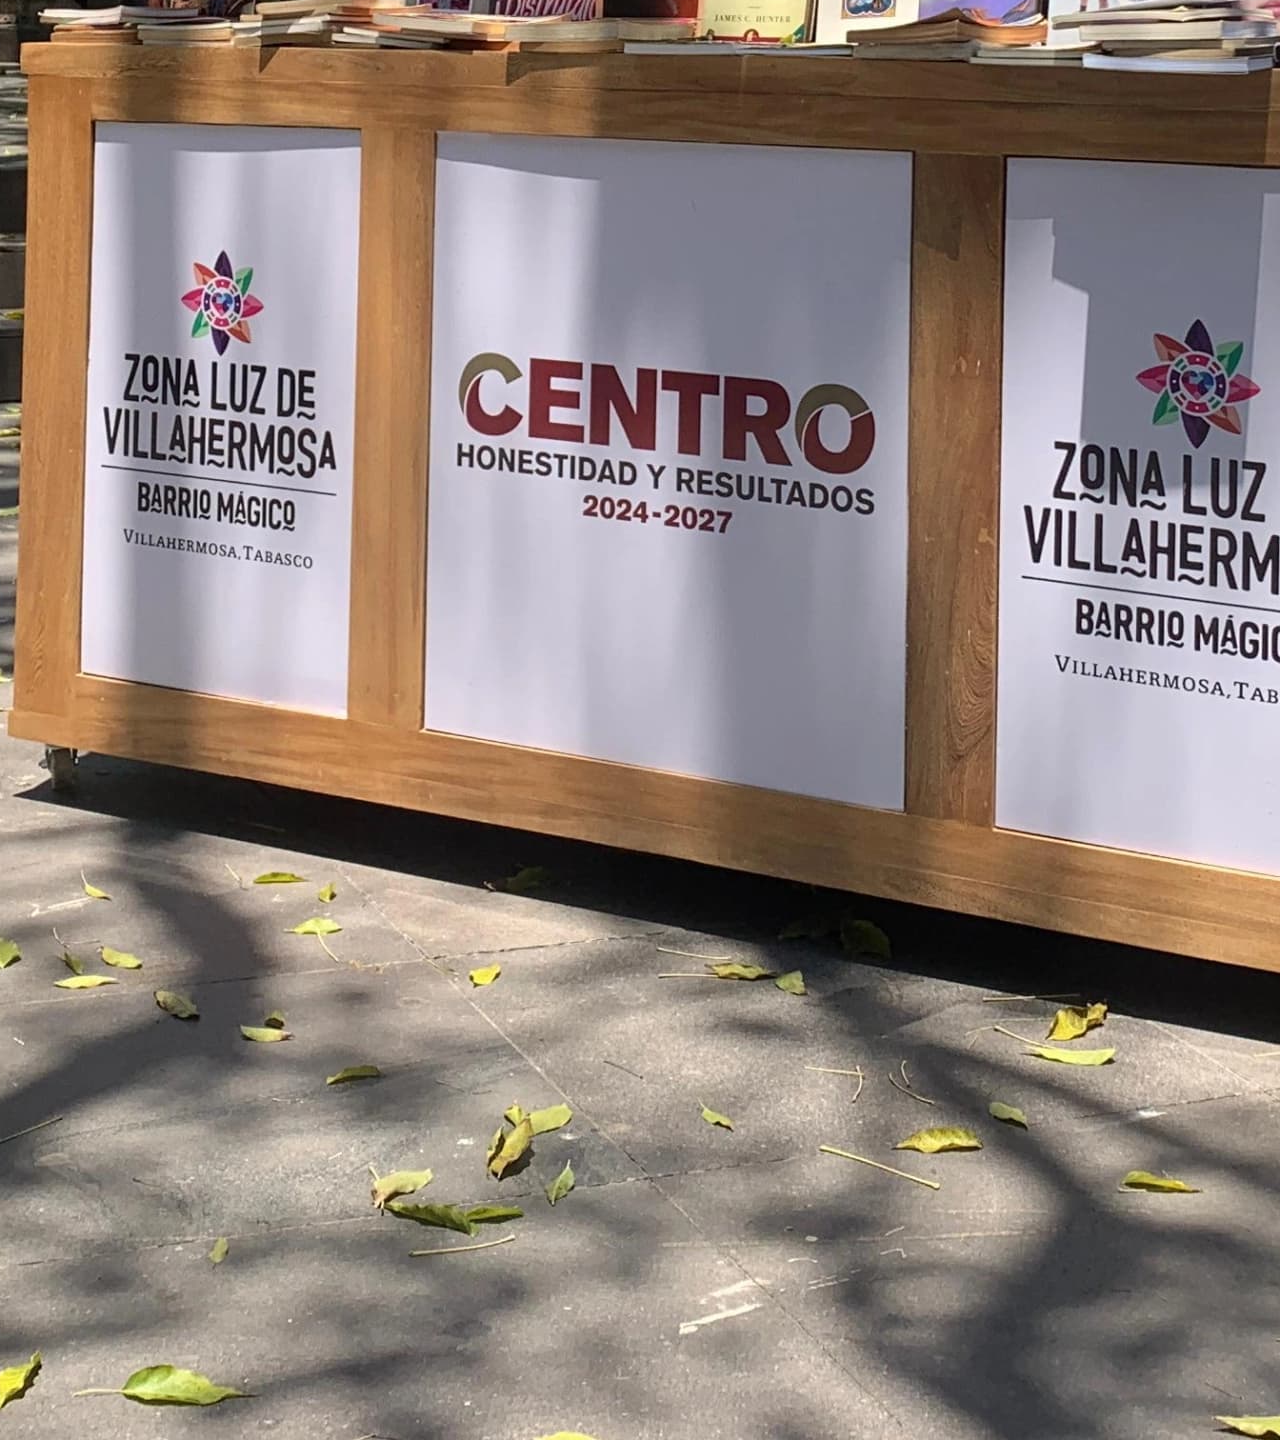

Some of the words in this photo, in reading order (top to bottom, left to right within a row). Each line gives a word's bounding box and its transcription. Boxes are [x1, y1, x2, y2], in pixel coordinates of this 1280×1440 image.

[714, 14, 742, 23] JAMES
[755, 15, 791, 23] HUNTER
[123, 353, 200, 408] ZONA
[210, 361, 267, 415] LUZ
[277, 368, 316, 420] DE
[458, 352, 876, 474] CENTRO
[103, 406, 337, 479] VILLAHERMOSA
[137, 481, 211, 520] BARRIO
[217, 490, 295, 532] MÁGICO
[456, 443, 637, 486] HONESTIDAD
[646, 464, 666, 489] Y
[675, 467, 875, 516] RESULTADOS
[1052, 440, 1167, 511] ZONA
[1181, 454, 1267, 522] LUZ
[582, 494, 733, 534] 2024-2027
[1075, 598, 1185, 648] BARRIO
